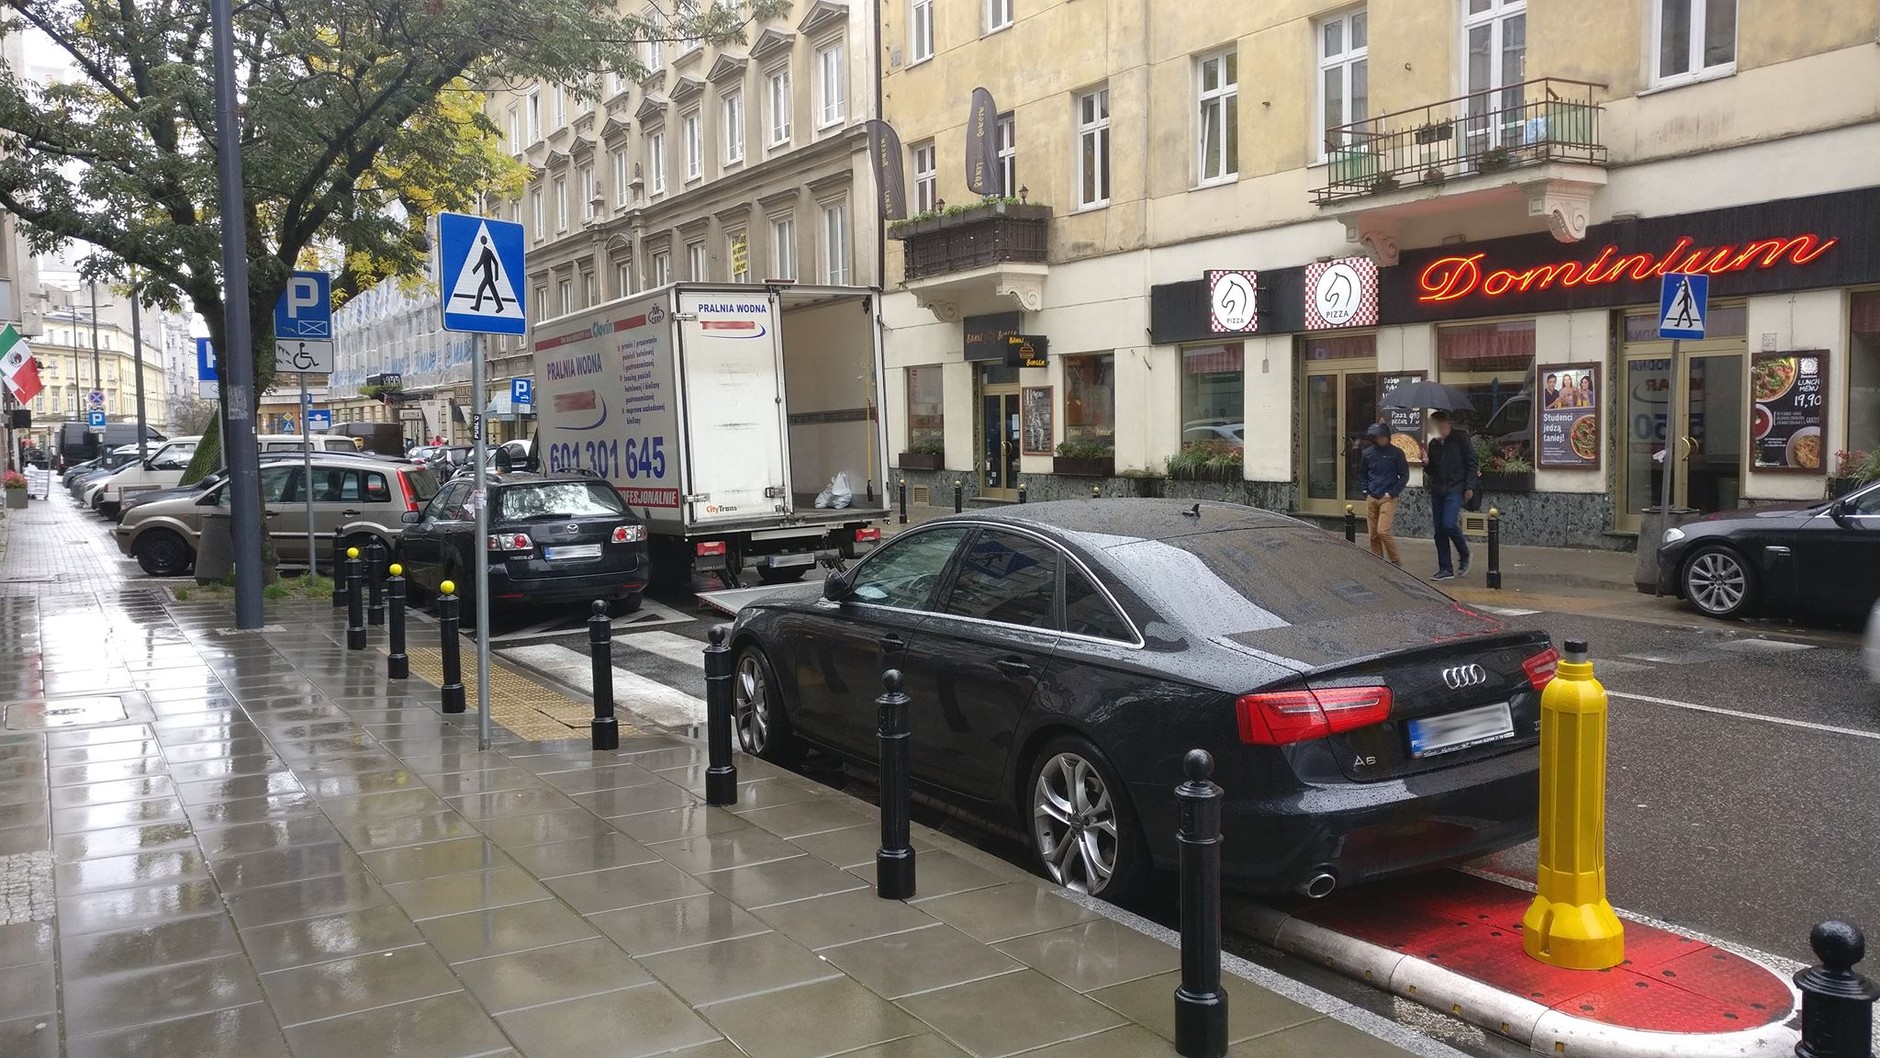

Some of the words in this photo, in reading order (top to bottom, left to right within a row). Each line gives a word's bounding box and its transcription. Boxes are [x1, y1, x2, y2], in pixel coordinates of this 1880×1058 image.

[1417, 234, 1839, 301] Dominium
[287, 277, 318, 319] P
[698, 304, 735, 313] PRALNIA
[736, 304, 767, 313] WODNA
[1326, 310, 1349, 319] PIZZA
[546, 359, 576, 380] PRALNIA
[575, 353, 603, 376] WODNA
[1794, 393, 1822, 408] 19,90
[1543, 413, 1573, 422] Studenci
[1543, 424, 1562, 433] jedzą
[1543, 434, 1565, 443] taniej!
[550, 442, 579, 473] 601
[586, 438, 619, 478] 301
[626, 436, 665, 479] 645
[1353, 755, 1377, 768] A6
